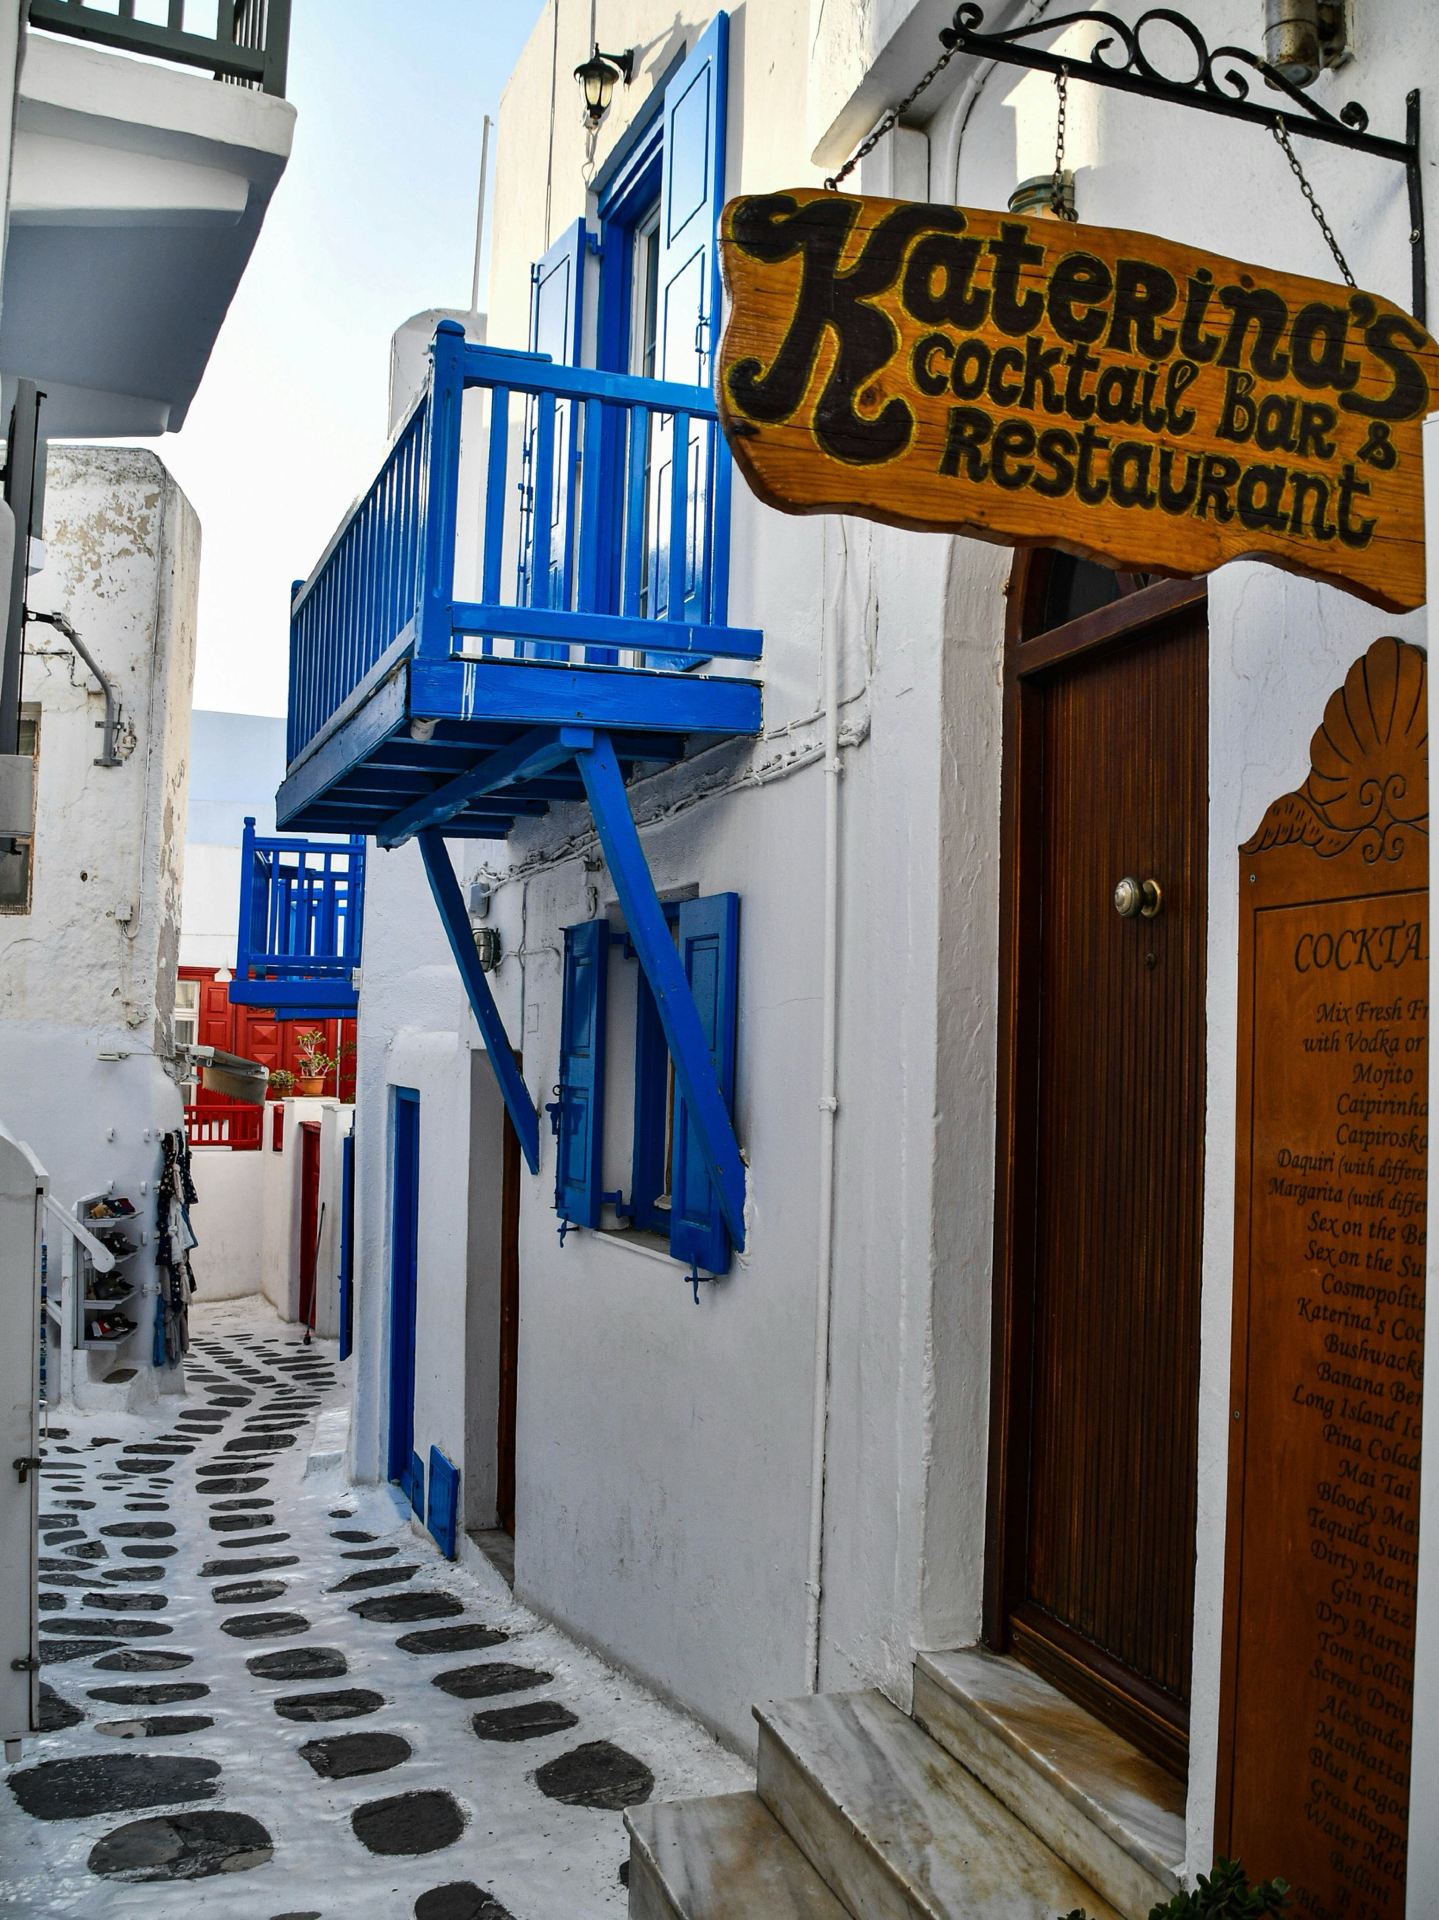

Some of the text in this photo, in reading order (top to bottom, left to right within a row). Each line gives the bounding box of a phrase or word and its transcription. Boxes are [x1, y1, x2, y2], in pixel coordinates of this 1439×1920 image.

[1357, 421, 1398, 470] &
[1295, 920, 1429, 973] COCKTA
[1316, 1002, 1350, 1025] Mix
[1356, 998, 1402, 1022] Fresh
[1303, 1029, 1425, 1058] with Vodka or
[1353, 1062, 1414, 1091] Mojito
[1277, 1148, 1428, 1185] Daquiri (with differe
[1268, 1177, 1343, 1206] Margarita
[1347, 1187, 1385, 1210] (with
[1307, 1211, 1340, 1238] Sex
[1342, 1221, 1363, 1237] on
[1369, 1216, 1396, 1241] the
[1304, 1240, 1427, 1279] Sex on the Su
[1317, 1361, 1385, 1397] Banana
[1292, 1384, 1335, 1420] Long
[1340, 1397, 1401, 1432] Island
[1323, 1424, 1362, 1453] Pina
[1338, 1459, 1413, 1501] Mai Tai
[1307, 1507, 1370, 1548] Tequila
[1317, 1481, 1419, 1536] Bloody Ma
[1311, 1539, 1358, 1579] Dirty
[1316, 1601, 1349, 1635] Dry
[1331, 1579, 1411, 1630] Gin Fizz
[1318, 1631, 1353, 1664] Tom
[1309, 1658, 1412, 1724] Screw Driv
[1309, 1747, 1348, 1783] Blue
[1314, 1720, 1410, 1789] Manhatta
[1304, 1802, 1406, 1884] Water Mel
